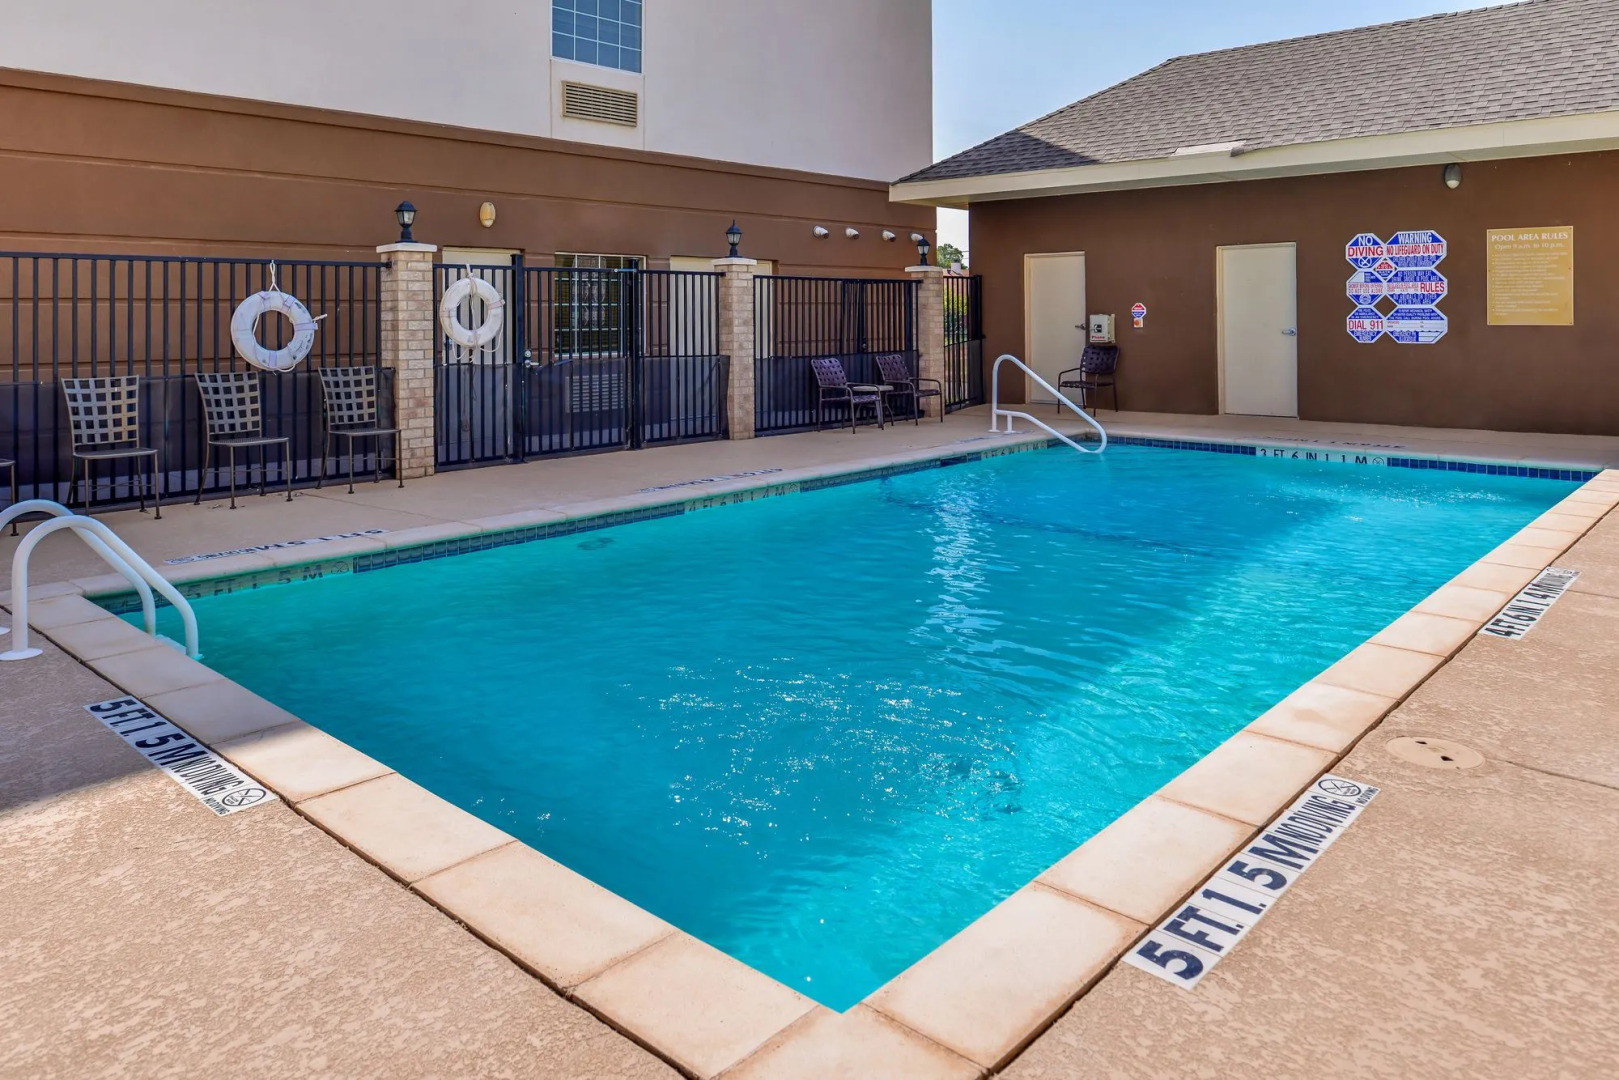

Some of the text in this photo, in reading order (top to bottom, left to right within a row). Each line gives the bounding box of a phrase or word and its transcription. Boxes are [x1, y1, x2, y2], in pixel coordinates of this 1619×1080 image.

[1358, 236, 1373, 246] NO
[1398, 232, 1433, 244] WARNING
[1491, 232, 1568, 242] POOL AREA RULES
[1348, 245, 1384, 257] DIVING
[1387, 243, 1444, 256] NO LIFEGUARD ON DUTY
[1420, 282, 1445, 293] RULES
[1349, 320, 1367, 330] DIAL
[1369, 320, 1383, 330] 911
[1273, 449, 1285, 457] FT
[1306, 452, 1317, 460] IN
[1355, 455, 1367, 464] M
[733, 493, 743, 504] IN
[303, 564, 323, 581] M
[90, 699, 136, 713] 5
[148, 743, 208, 766] M
[169, 756, 217, 774] NO
[180, 764, 245, 795] DIVING
[208, 802, 231, 815] DIVING
[1288, 795, 1356, 833] DIVING
[1274, 822, 1328, 847] NO
[1248, 834, 1320, 870] M
[1163, 905, 1244, 953] FT.
[1136, 940, 1204, 980] 5
